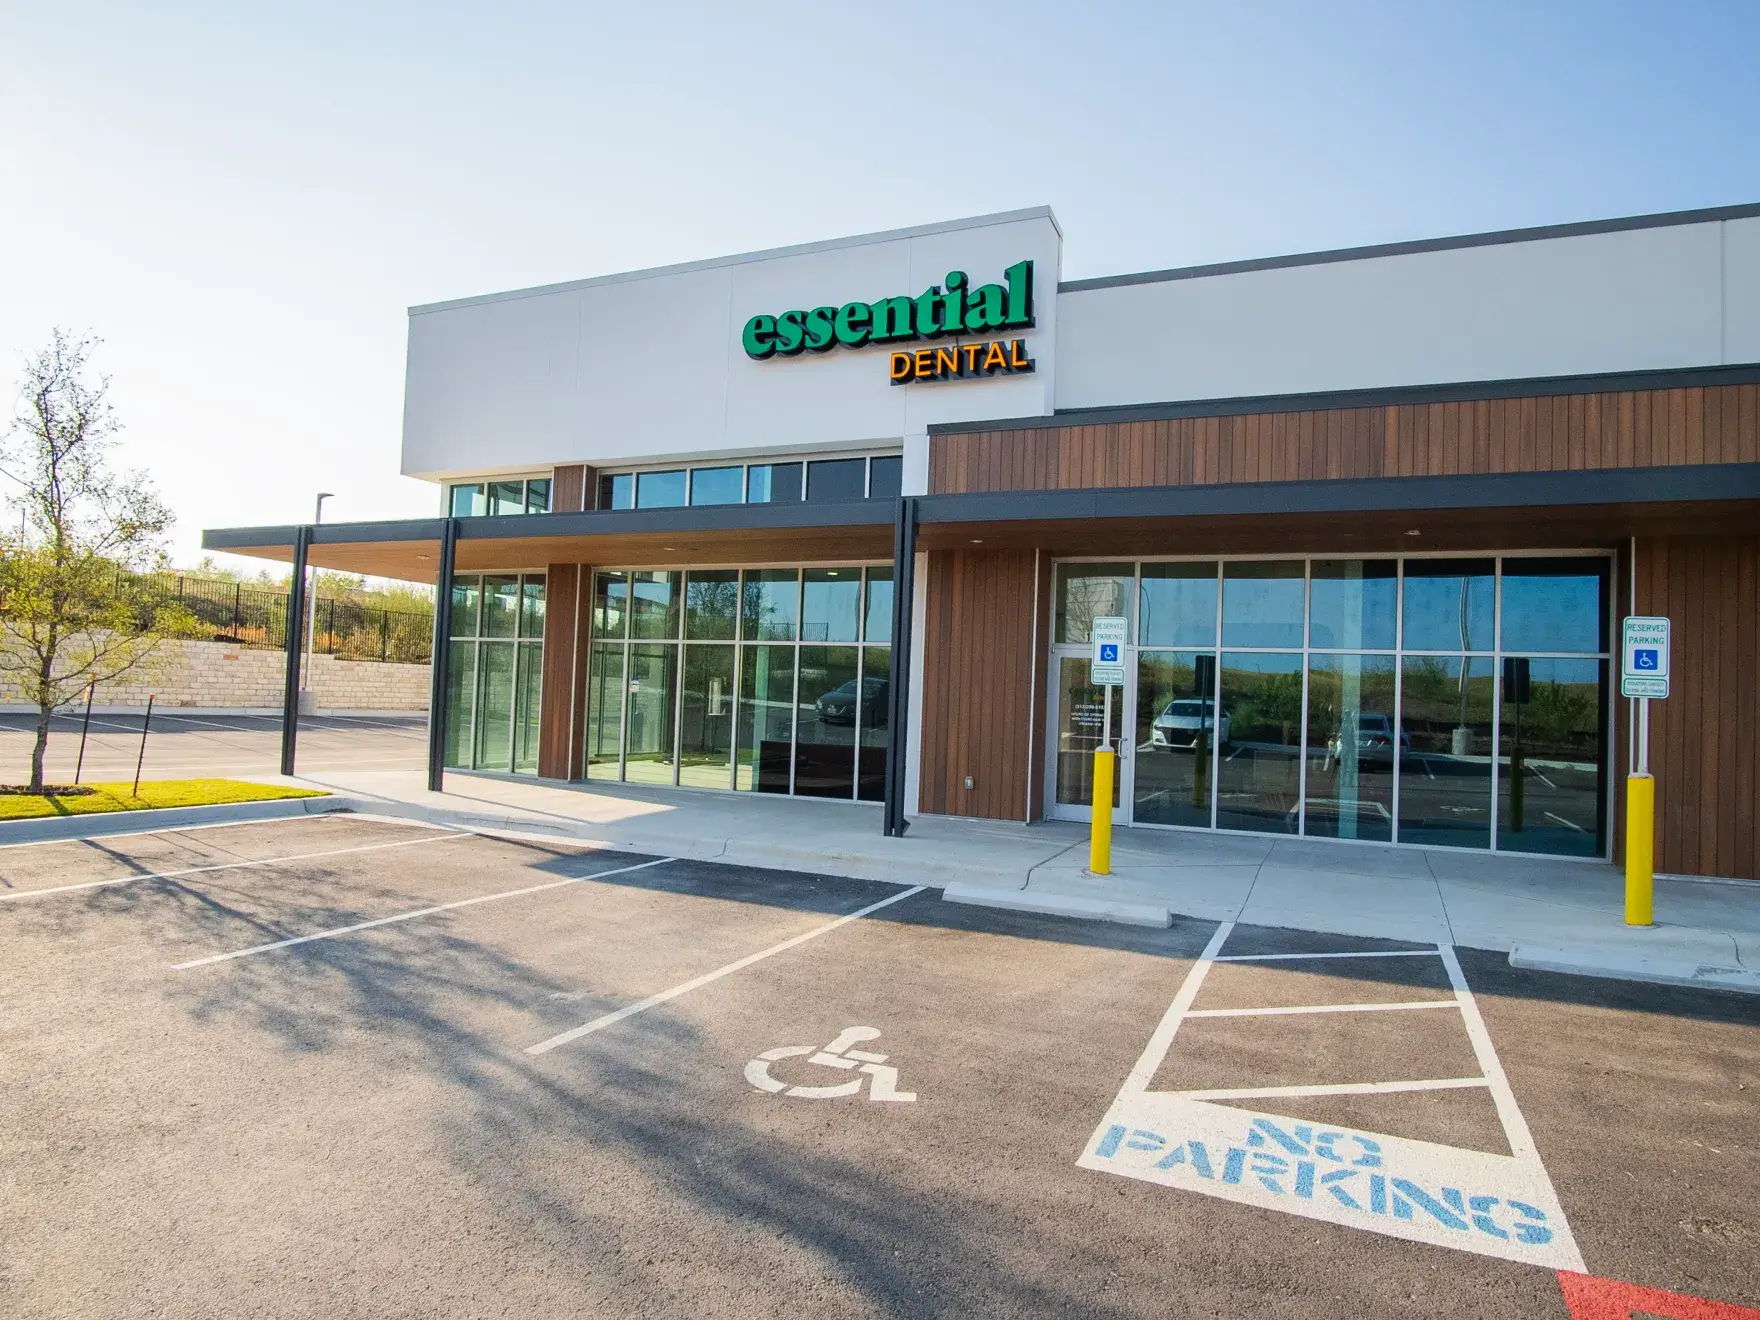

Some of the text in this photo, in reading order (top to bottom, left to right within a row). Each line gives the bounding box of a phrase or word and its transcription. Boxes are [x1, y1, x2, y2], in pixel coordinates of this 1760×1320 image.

[742, 259, 1036, 360] essential
[890, 338, 1036, 386] DENTAL
[1095, 622, 1125, 630] RESERVED
[1627, 623, 1667, 632] RESERVED
[1628, 636, 1665, 645] PARKING
[1248, 1117, 1382, 1169] NO
[1094, 1124, 1553, 1245] PARKING
